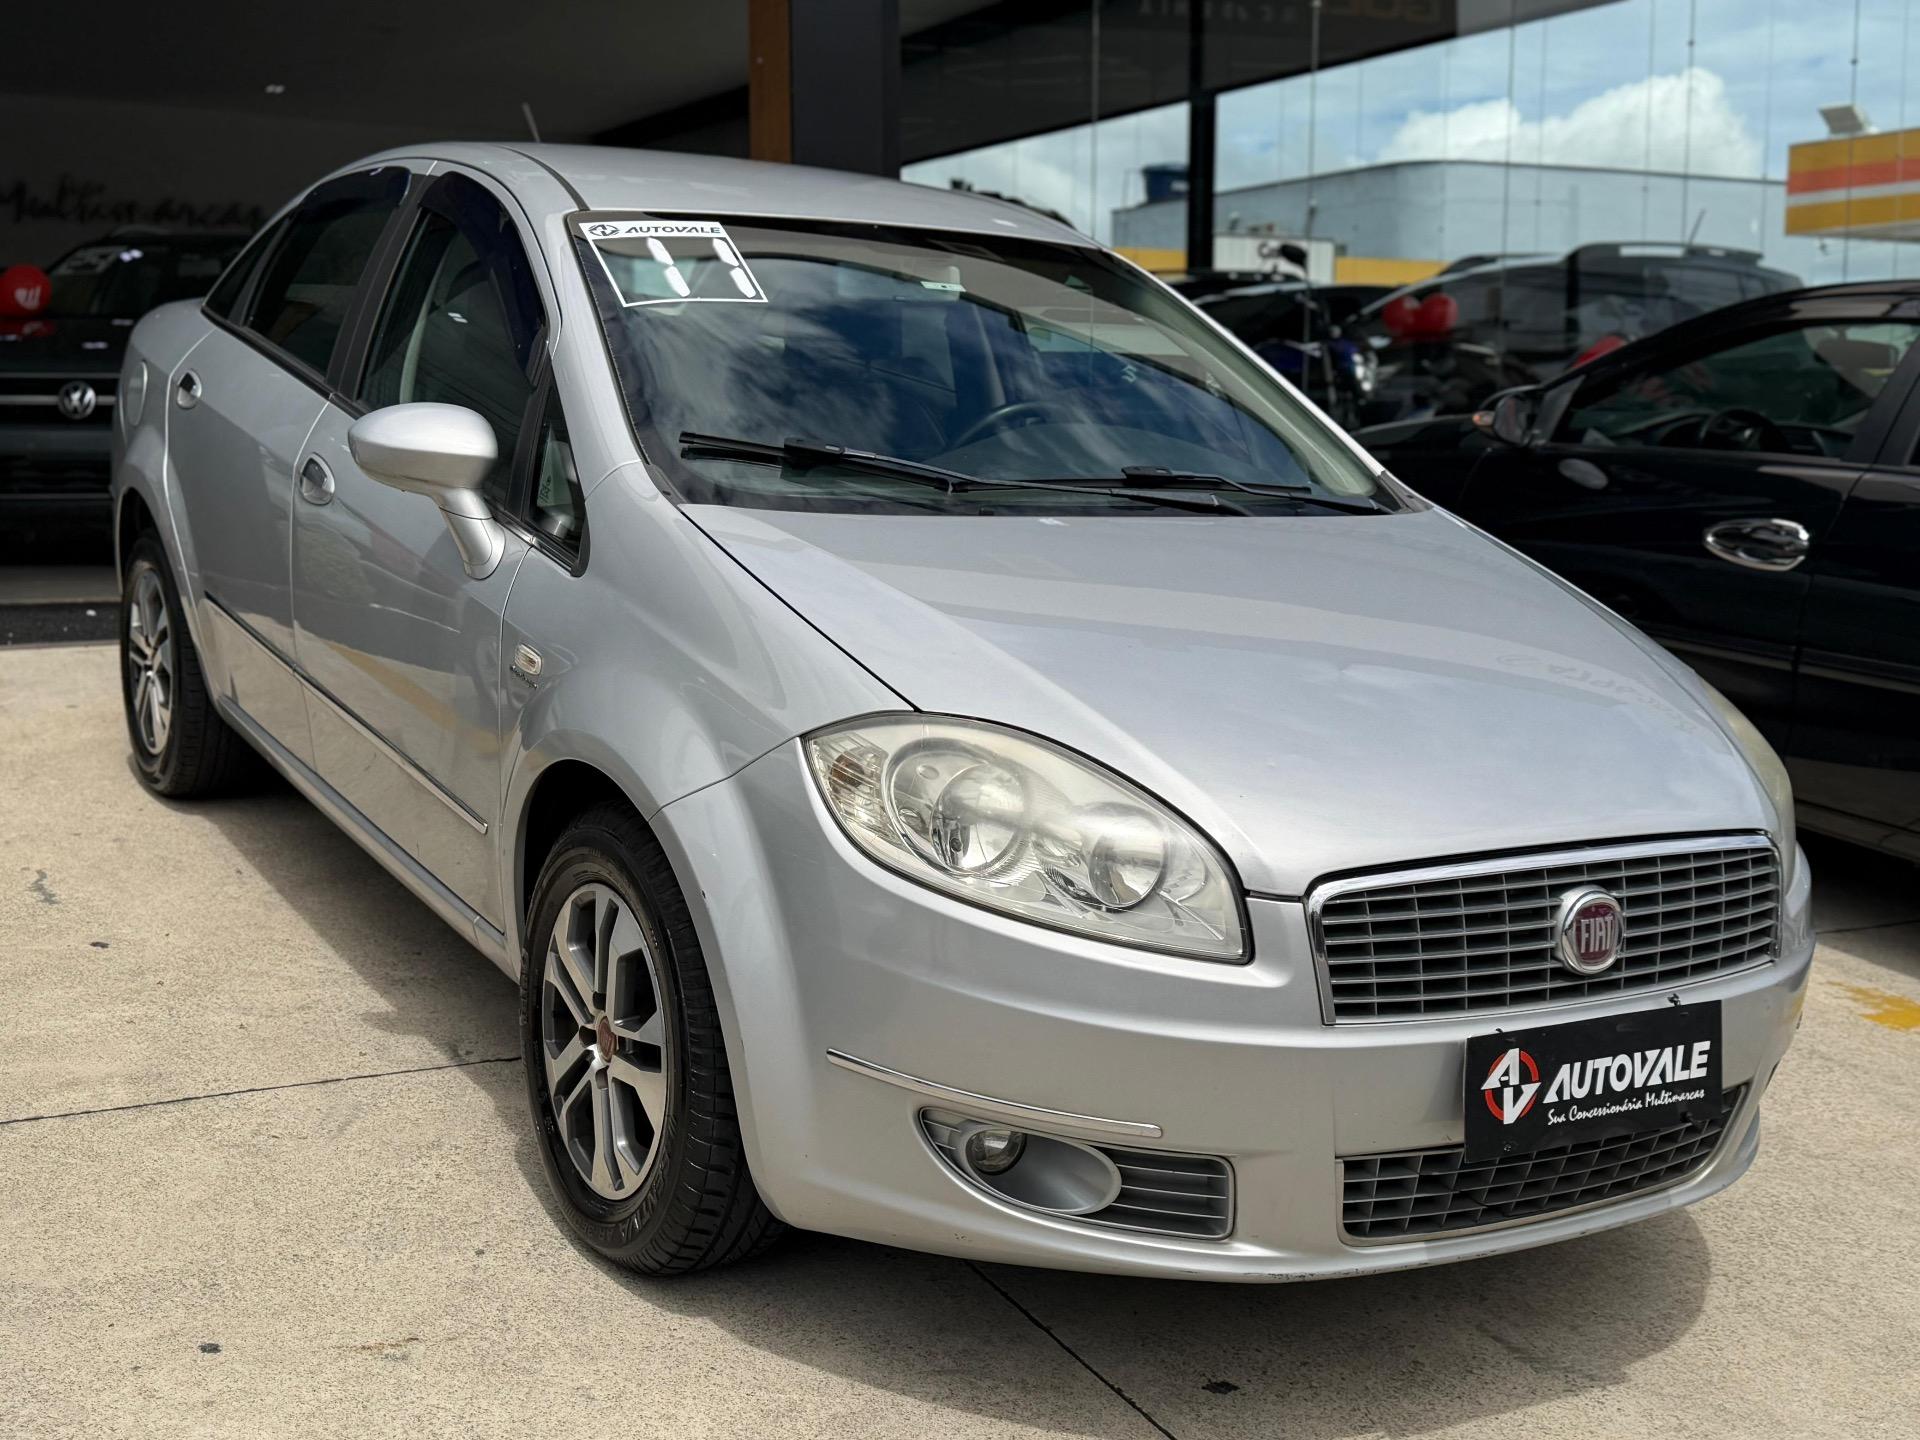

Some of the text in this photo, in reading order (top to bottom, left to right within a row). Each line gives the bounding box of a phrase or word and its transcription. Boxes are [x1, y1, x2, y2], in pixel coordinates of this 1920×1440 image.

[624, 225, 722, 235] AUTOVALE
[1580, 914, 1614, 954] FIAT
[1542, 1040, 1711, 1104] AUTOVALE
[1547, 1089, 1705, 1126] Sua Concessionária Multimarcas
